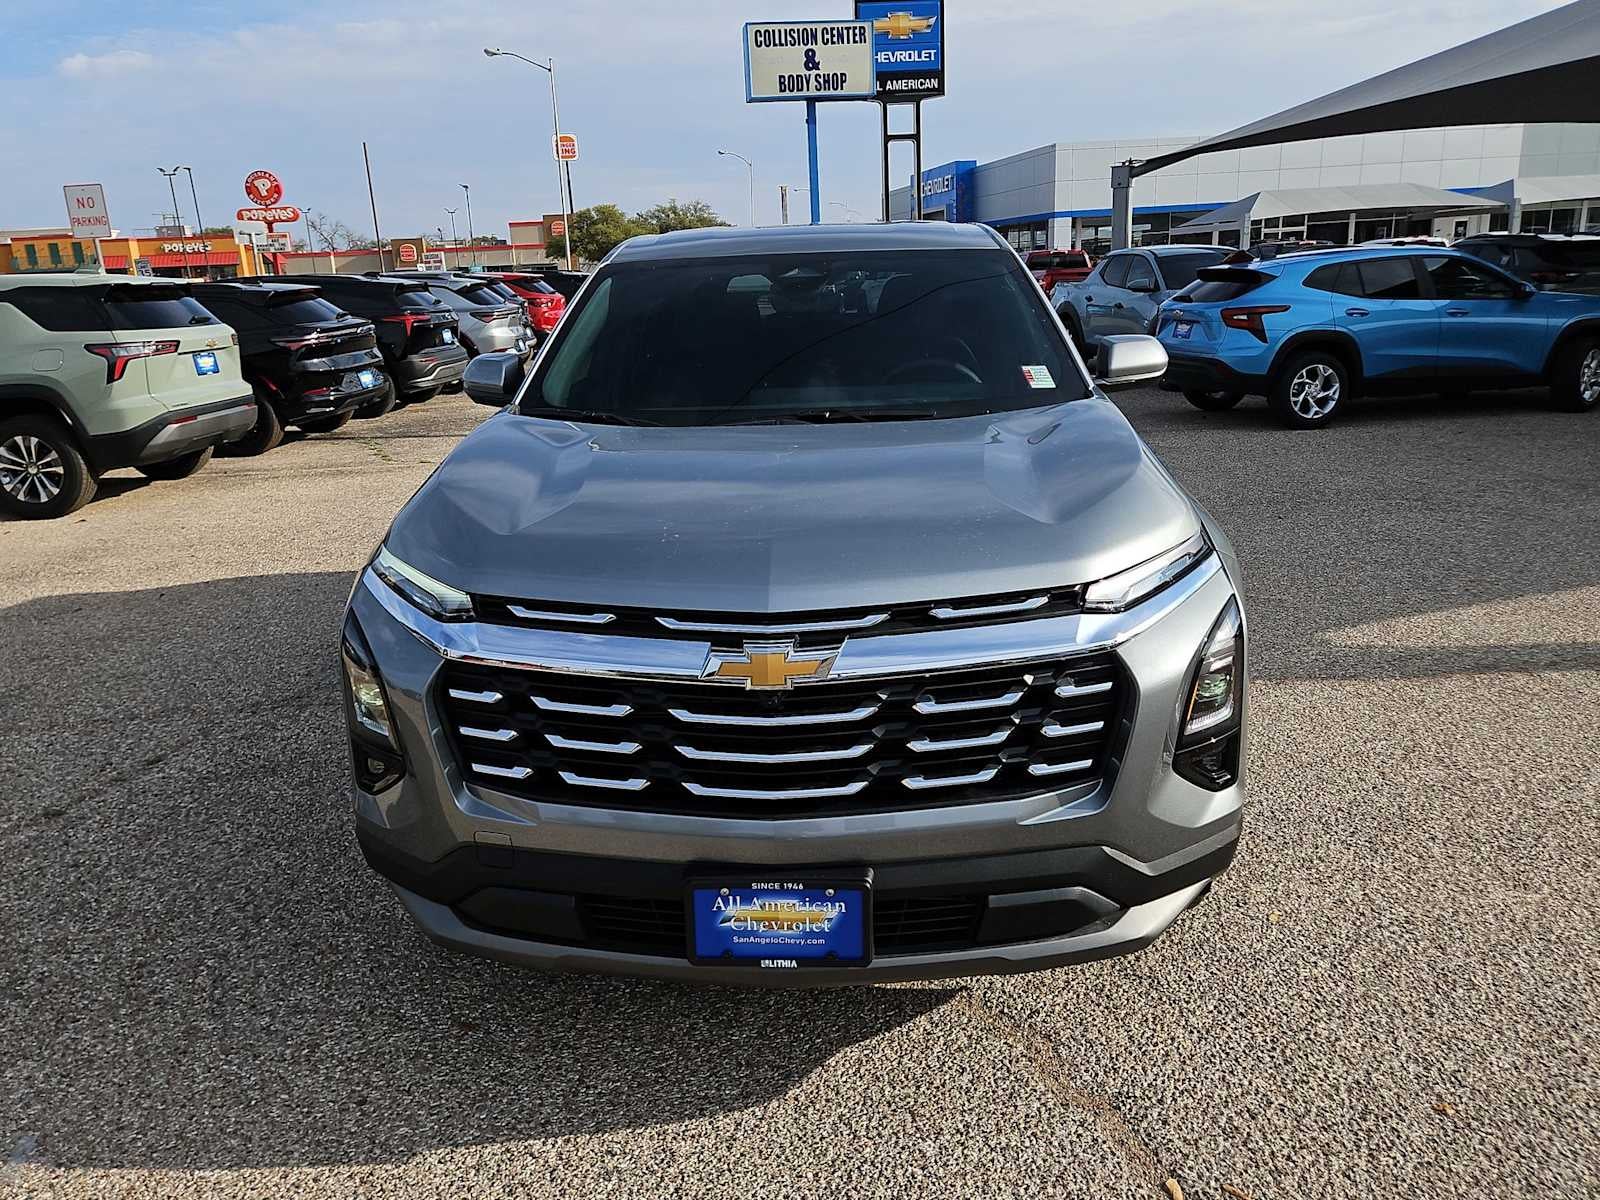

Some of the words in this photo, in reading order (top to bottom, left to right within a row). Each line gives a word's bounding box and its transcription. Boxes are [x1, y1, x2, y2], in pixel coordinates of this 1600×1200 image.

[754, 28, 818, 48] COLLISION
[821, 26, 867, 46] CENTER
[804, 48, 820, 71] &
[874, 50, 936, 63] HEVROLET
[778, 74, 811, 93] BODY
[815, 72, 847, 92] SHOP
[886, 78, 938, 91] AMERICAN
[253, 179, 271, 197] P
[76, 196, 95, 208] NO
[72, 215, 107, 226] PARKING
[751, 882, 780, 890] SINCE
[783, 882, 804, 890] 1946
[712, 896, 741, 911] All
[750, 897, 846, 913] American
[731, 916, 831, 933] Chevrolet
[733, 935, 825, 945] SanAngeloChevy.com
